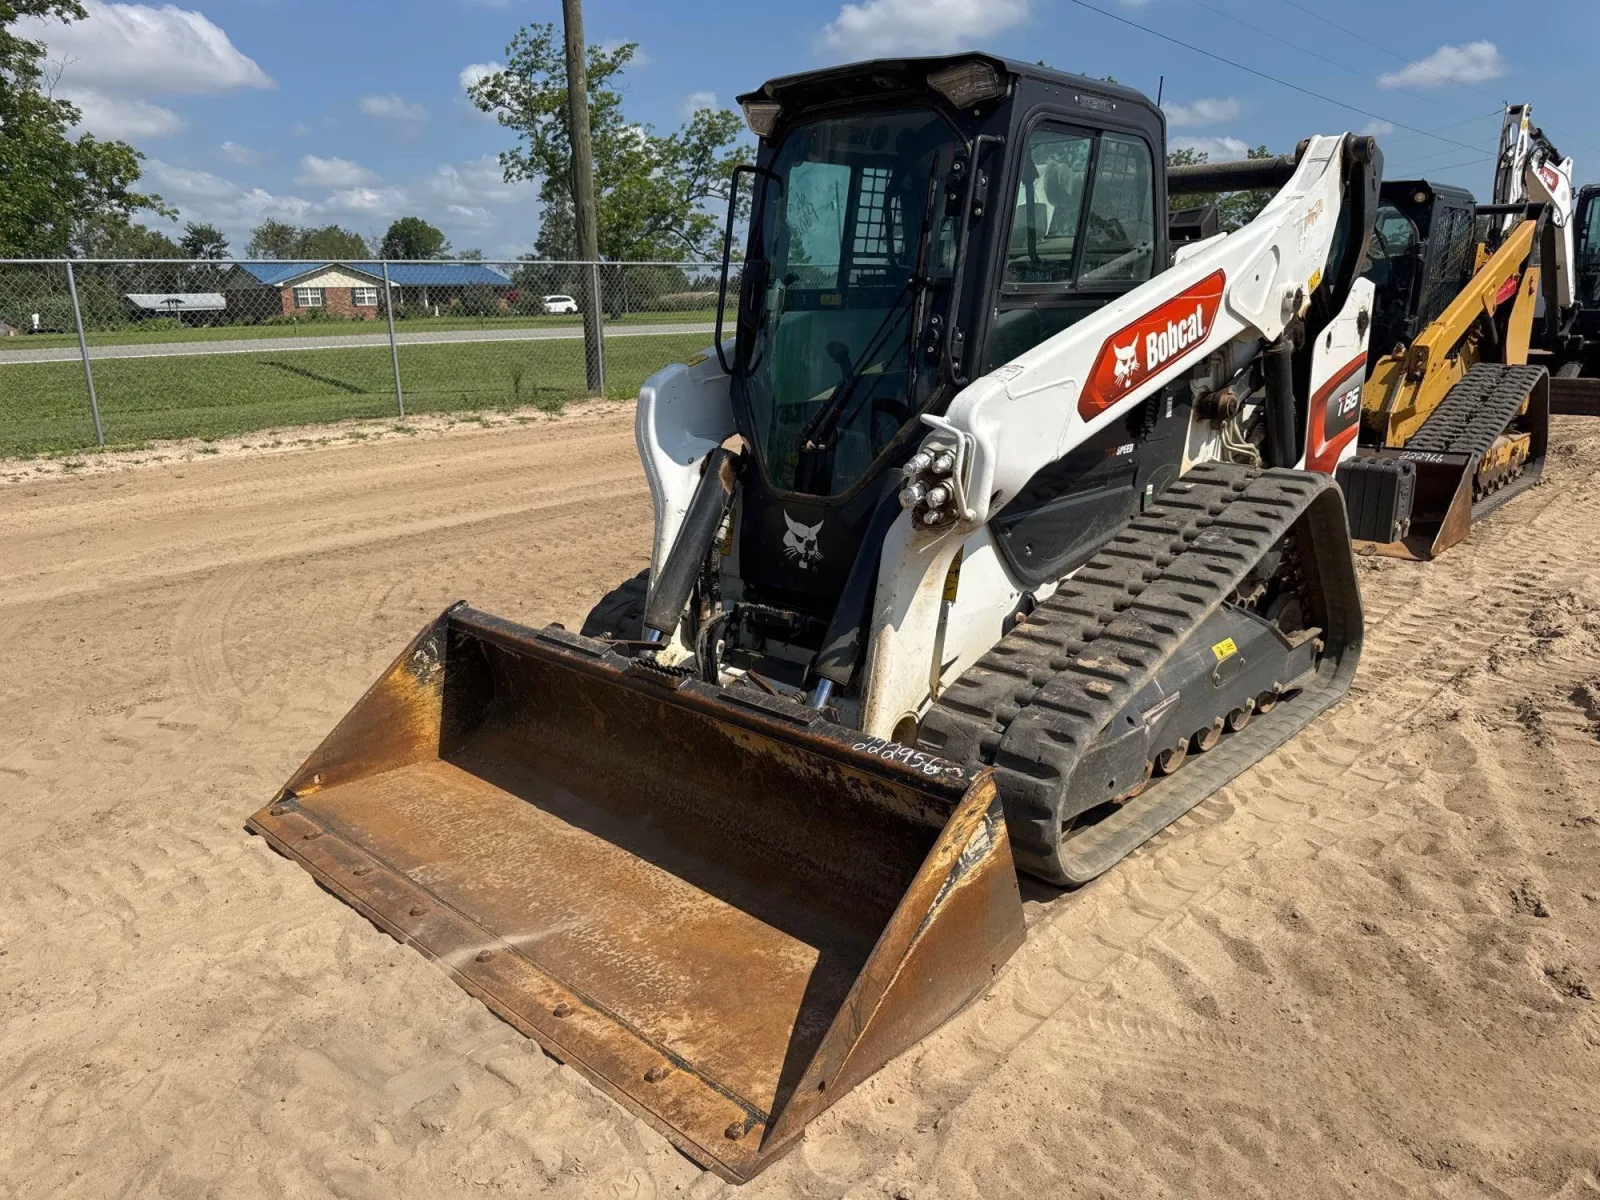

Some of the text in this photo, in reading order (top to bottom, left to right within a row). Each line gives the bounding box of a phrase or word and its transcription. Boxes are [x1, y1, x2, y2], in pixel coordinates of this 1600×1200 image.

[1146, 303, 1203, 371] Bobcat
[1337, 385, 1360, 417] T86
[1115, 443, 1134, 456] SPEED
[1398, 451, 1444, 463] 222966
[852, 736, 948, 775] 222956
